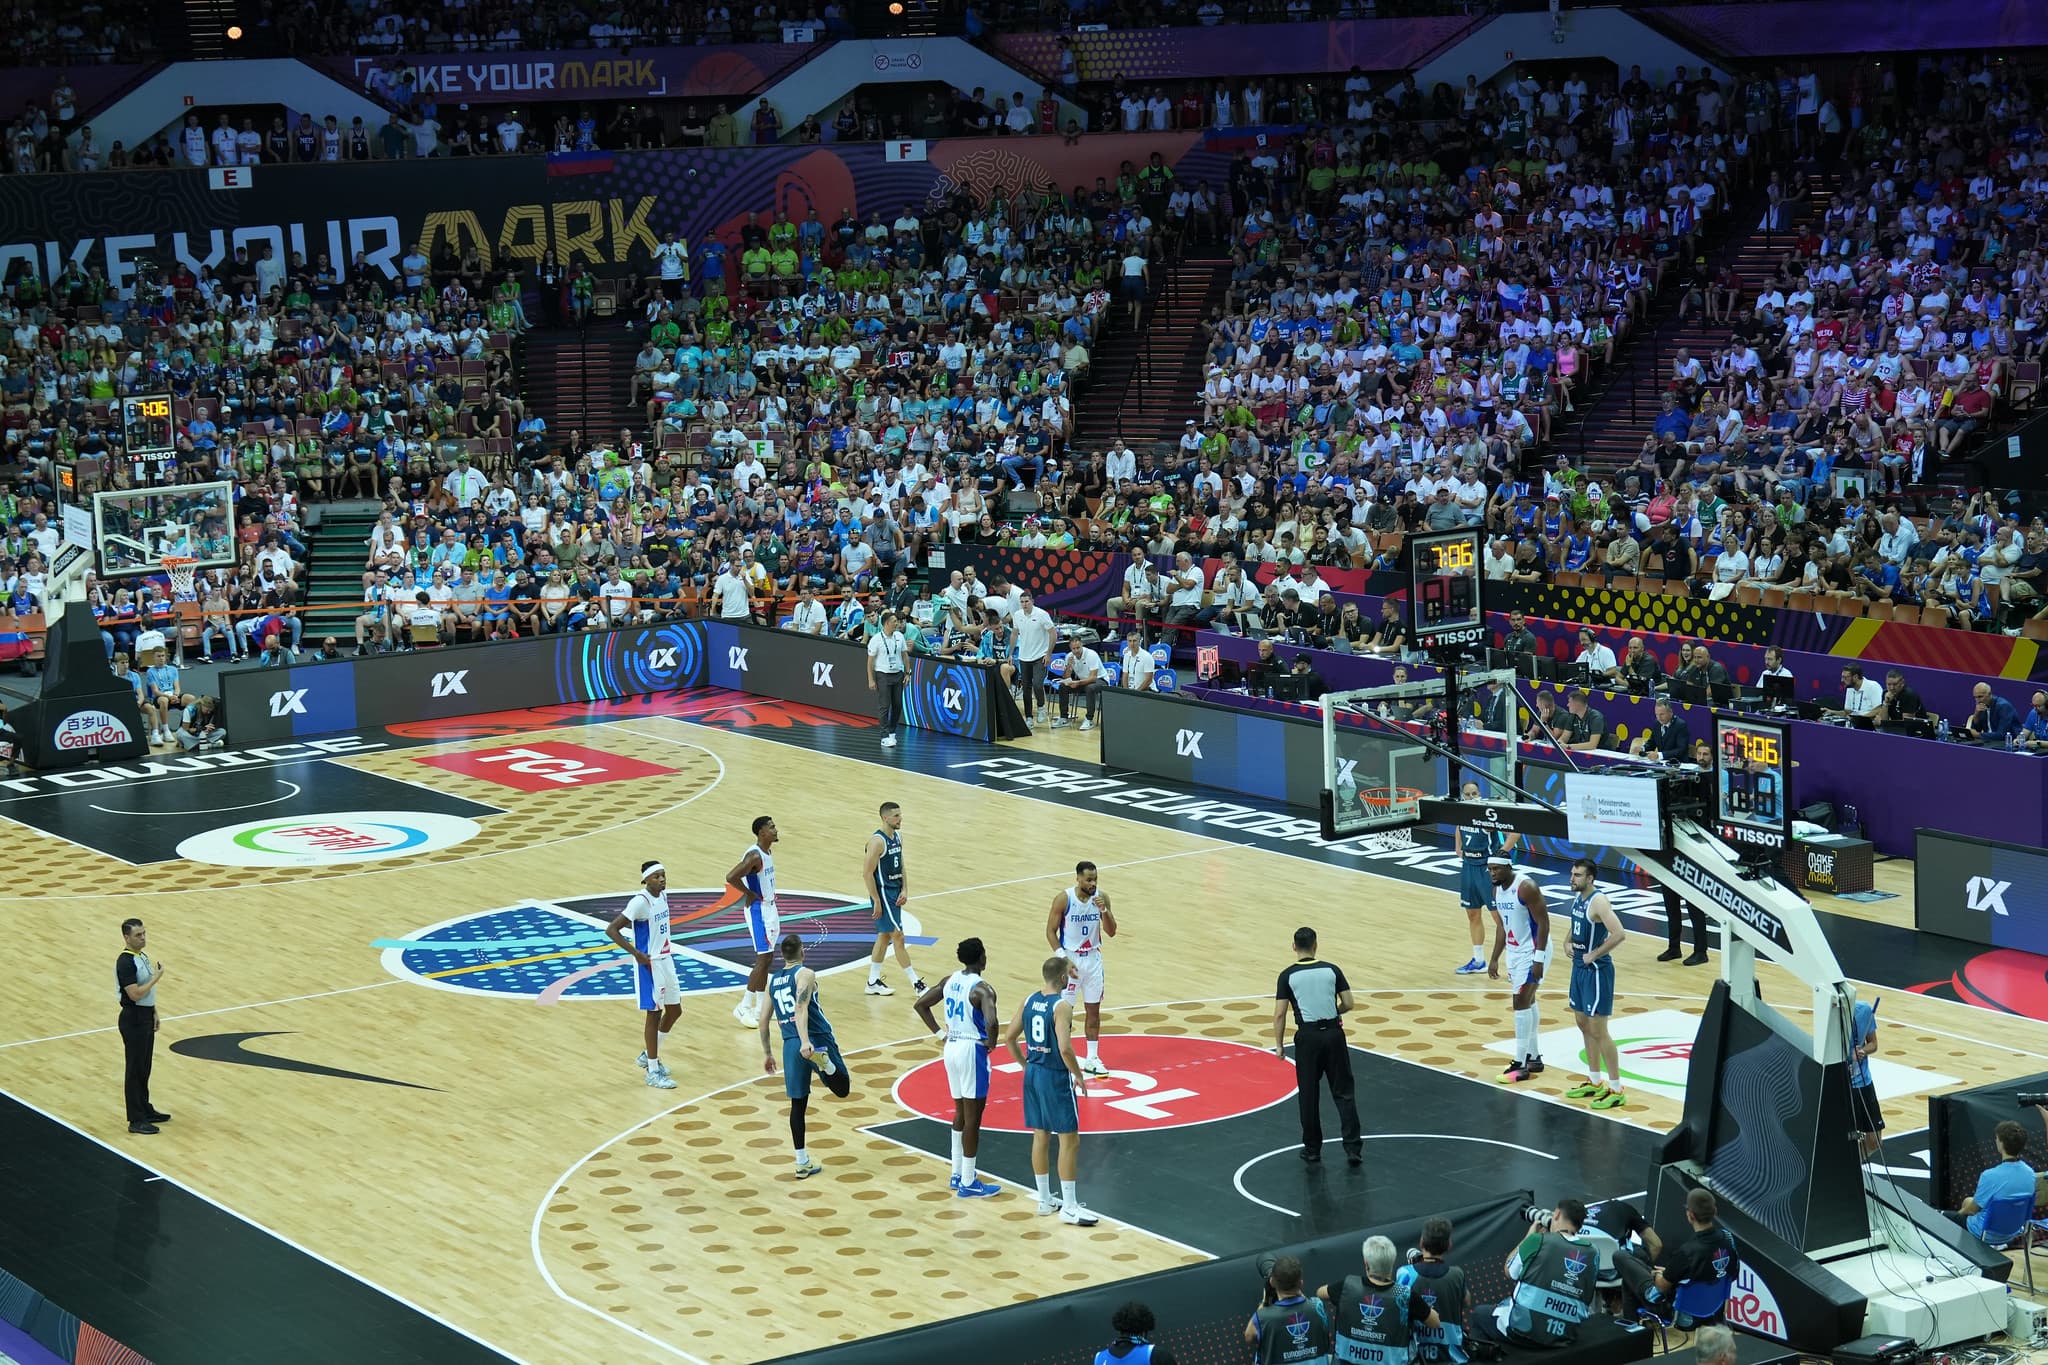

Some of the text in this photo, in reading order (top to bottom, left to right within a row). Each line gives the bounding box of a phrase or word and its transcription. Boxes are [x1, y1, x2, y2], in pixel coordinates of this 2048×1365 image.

[365, 59, 657, 95] AKE YOUR MARK
[900, 143, 912, 159] F
[224, 170, 238, 186] E
[172, 215, 401, 287] YOUR
[415, 195, 662, 272] MARK
[137, 401, 169, 417] 7:06
[142, 451, 177, 461] TISSOT
[755, 442, 766, 457] F
[1431, 543, 1473, 568] 7:06
[1435, 627, 1486, 646] TISSOT
[649, 646, 678, 669] 1X
[728, 646, 749, 672] 1X
[431, 669, 469, 698] 1X
[812, 661, 834, 688] 1X
[269, 688, 309, 717] 1X
[942, 687, 962, 711] 1X
[67, 715, 110, 731] 百岁山
[1175, 728, 1205, 760] 1X
[1736, 733, 1779, 765] 7:06
[474, 748, 609, 784] TCL
[1465, 835, 1472, 846] 7
[1736, 826, 1785, 848] TISSOT
[894, 856, 899, 868] 6
[1808, 851, 1835, 868] MAKE
[1808, 862, 1832, 876] YOUR
[1808, 870, 1835, 886] MARK
[1672, 855, 1782, 939] #EUROBASKET
[1965, 875, 2013, 917] 1X
[1071, 913, 1099, 922] FRANCE
[1082, 925, 1089, 936] 0
[773, 986, 796, 1016] 15
[945, 997, 964, 1022] 34
[1031, 1015, 1045, 1043] 8
[1544, 1297, 1579, 1317] PHOTO
[1416, 1326, 1445, 1340] HOTO
[1546, 1319, 1567, 1337] 119
[1349, 1345, 1384, 1363] PHOTO
